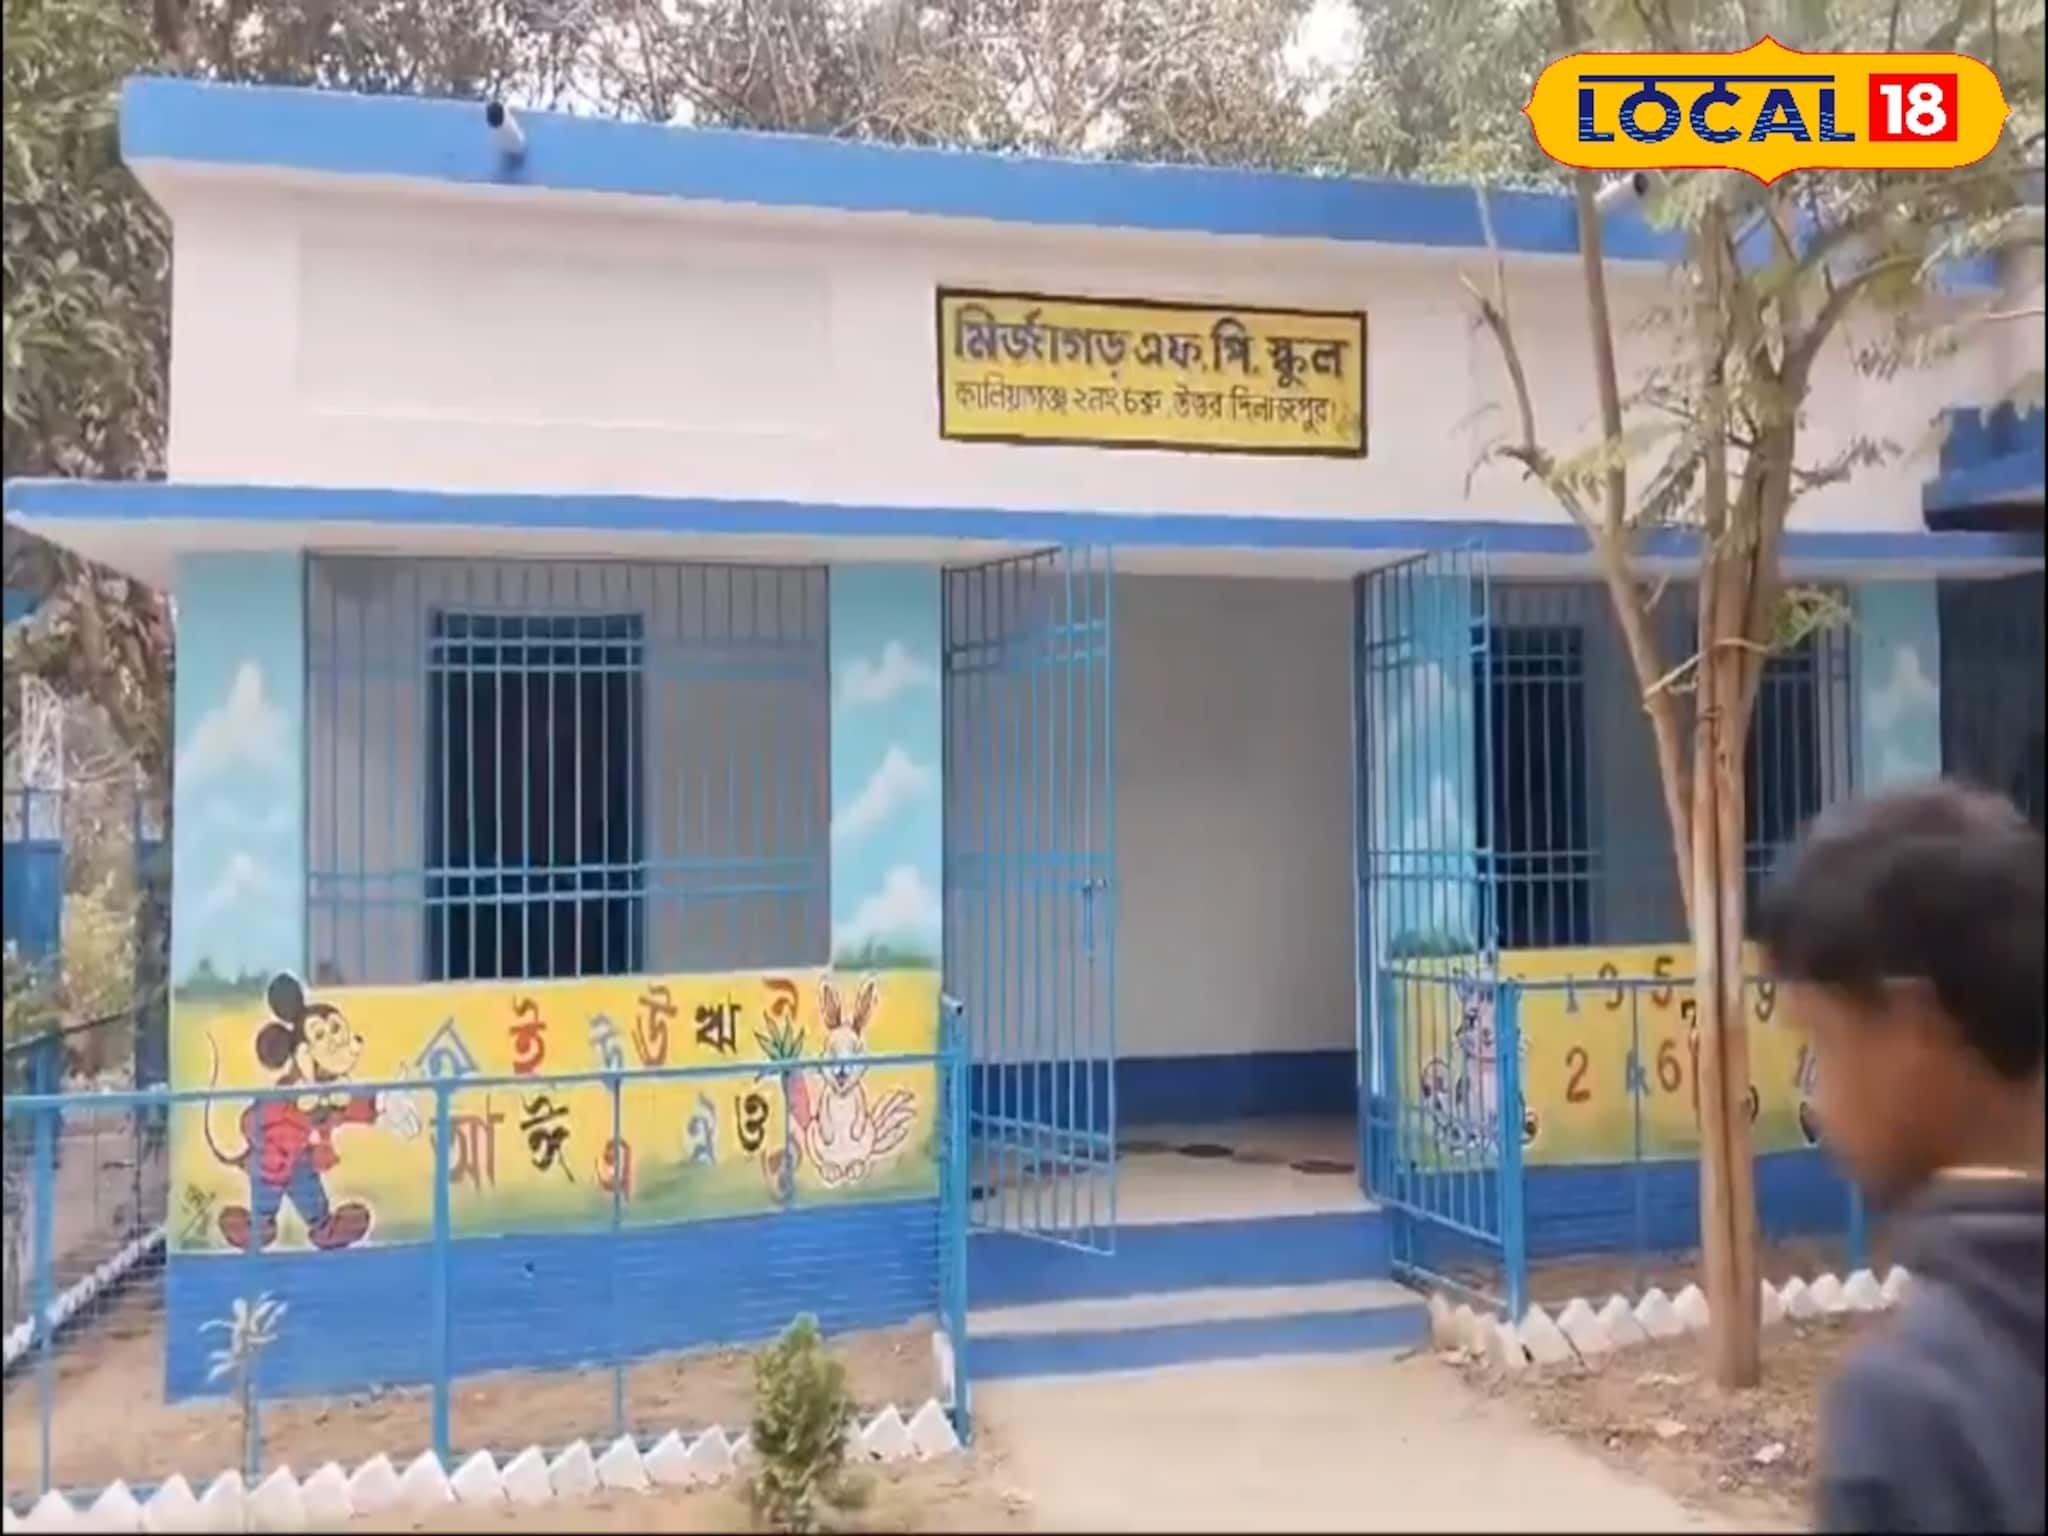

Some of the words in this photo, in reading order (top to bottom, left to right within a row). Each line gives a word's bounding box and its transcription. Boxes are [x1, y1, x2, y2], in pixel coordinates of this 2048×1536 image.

[1264, 336, 1350, 390] স্কুল
[1652, 955, 1675, 1009] 5
[1565, 1045, 1592, 1104] 2
[1656, 1039, 1682, 1094] 6
